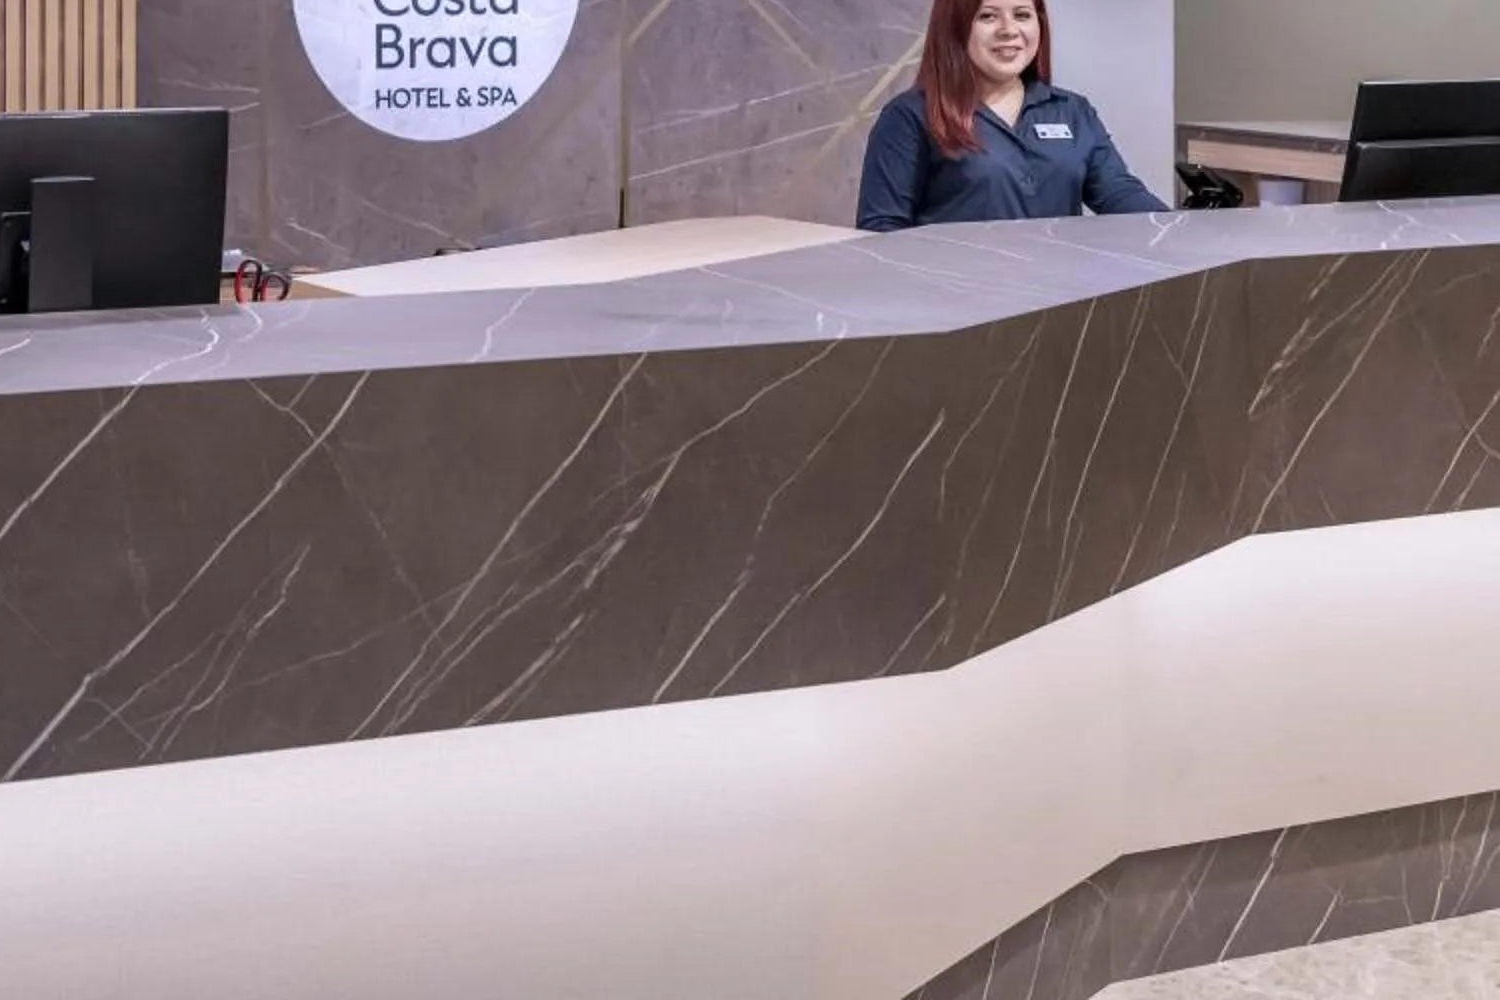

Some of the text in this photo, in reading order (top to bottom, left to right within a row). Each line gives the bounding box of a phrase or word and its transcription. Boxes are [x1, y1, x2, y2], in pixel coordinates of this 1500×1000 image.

[374, 22, 518, 70] Brava
[374, 86, 518, 110] HOTEL & SPA
